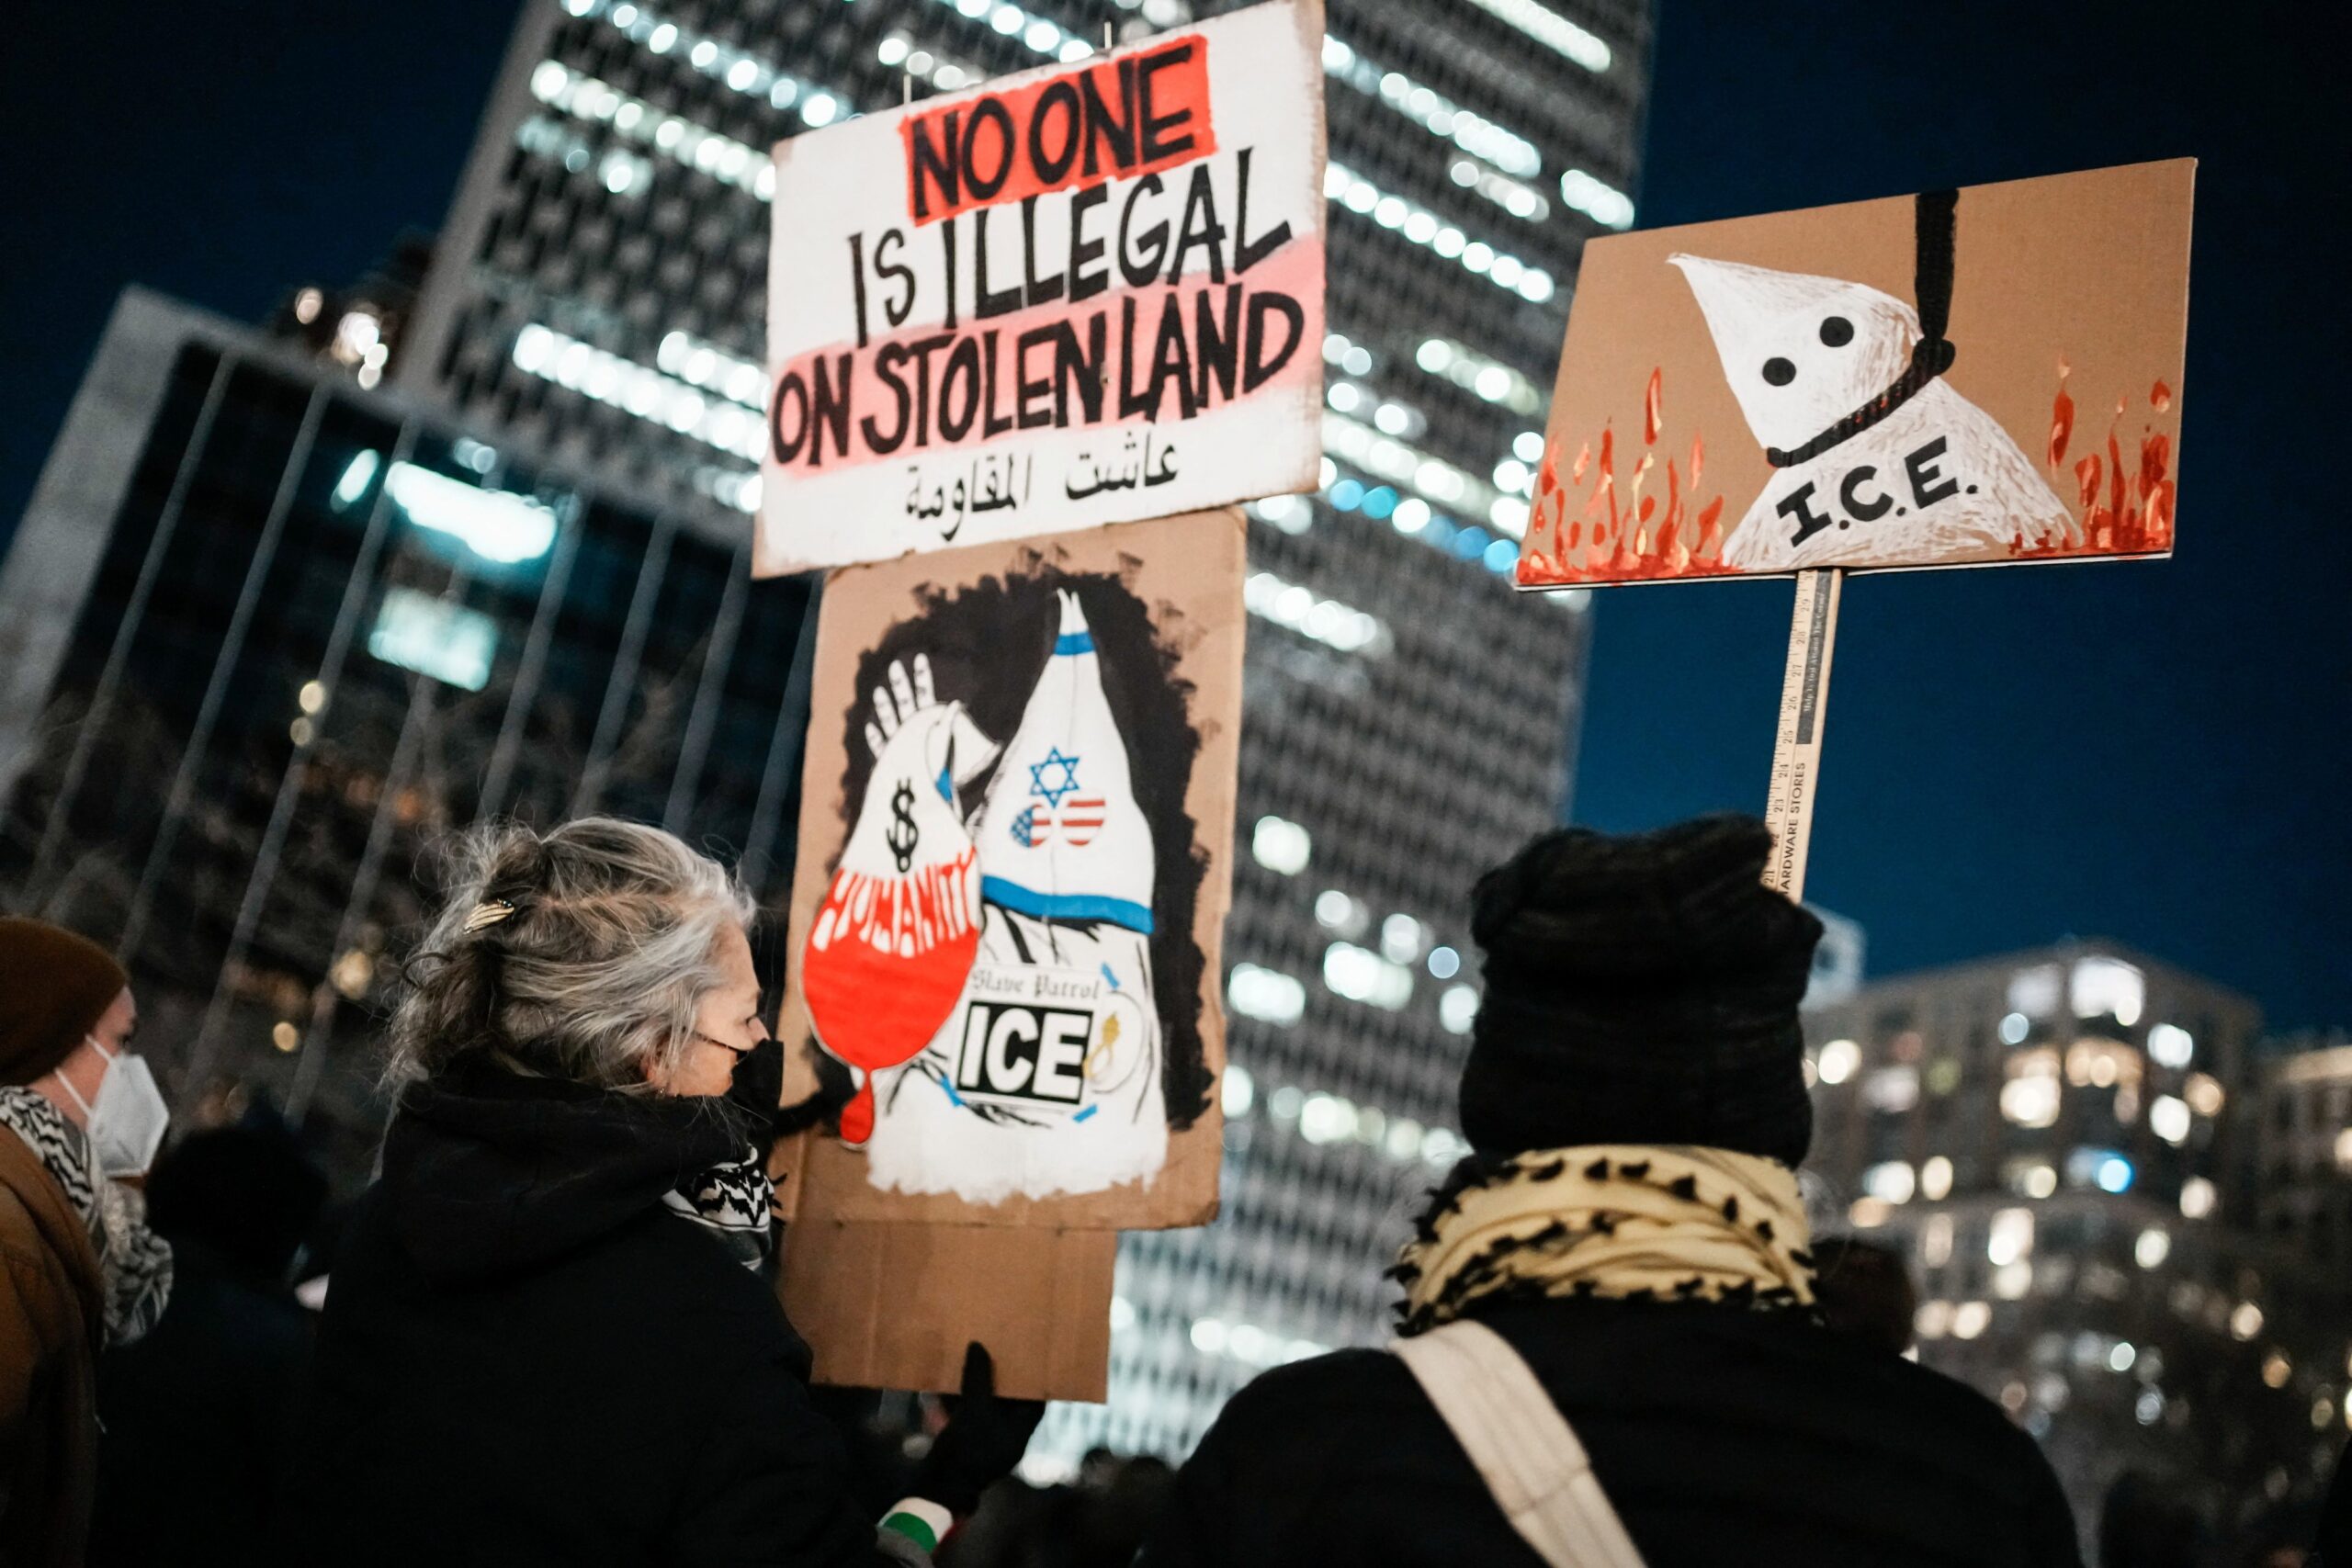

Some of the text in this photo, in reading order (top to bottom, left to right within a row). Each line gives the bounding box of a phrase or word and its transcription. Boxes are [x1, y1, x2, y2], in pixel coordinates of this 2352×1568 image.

[911, 44, 1194, 219] NO ONE
[848, 146, 1293, 348] IS ILLEGAL
[772, 280, 1306, 468] ON STOLEN LAND
[907, 431, 1179, 542] عاشت المقاومة
[1776, 435, 1978, 547] I.C.E.
[1788, 696, 1798, 710] 26
[1792, 664, 1803, 678] 27
[1779, 763, 1789, 778] 24
[1783, 730, 1793, 744] 25
[1773, 798, 1784, 812] 23
[1781, 762, 1806, 895] ARDWARE STORES
[972, 969, 1100, 999] Slave Patrol
[959, 1004, 1091, 1100] ICE
